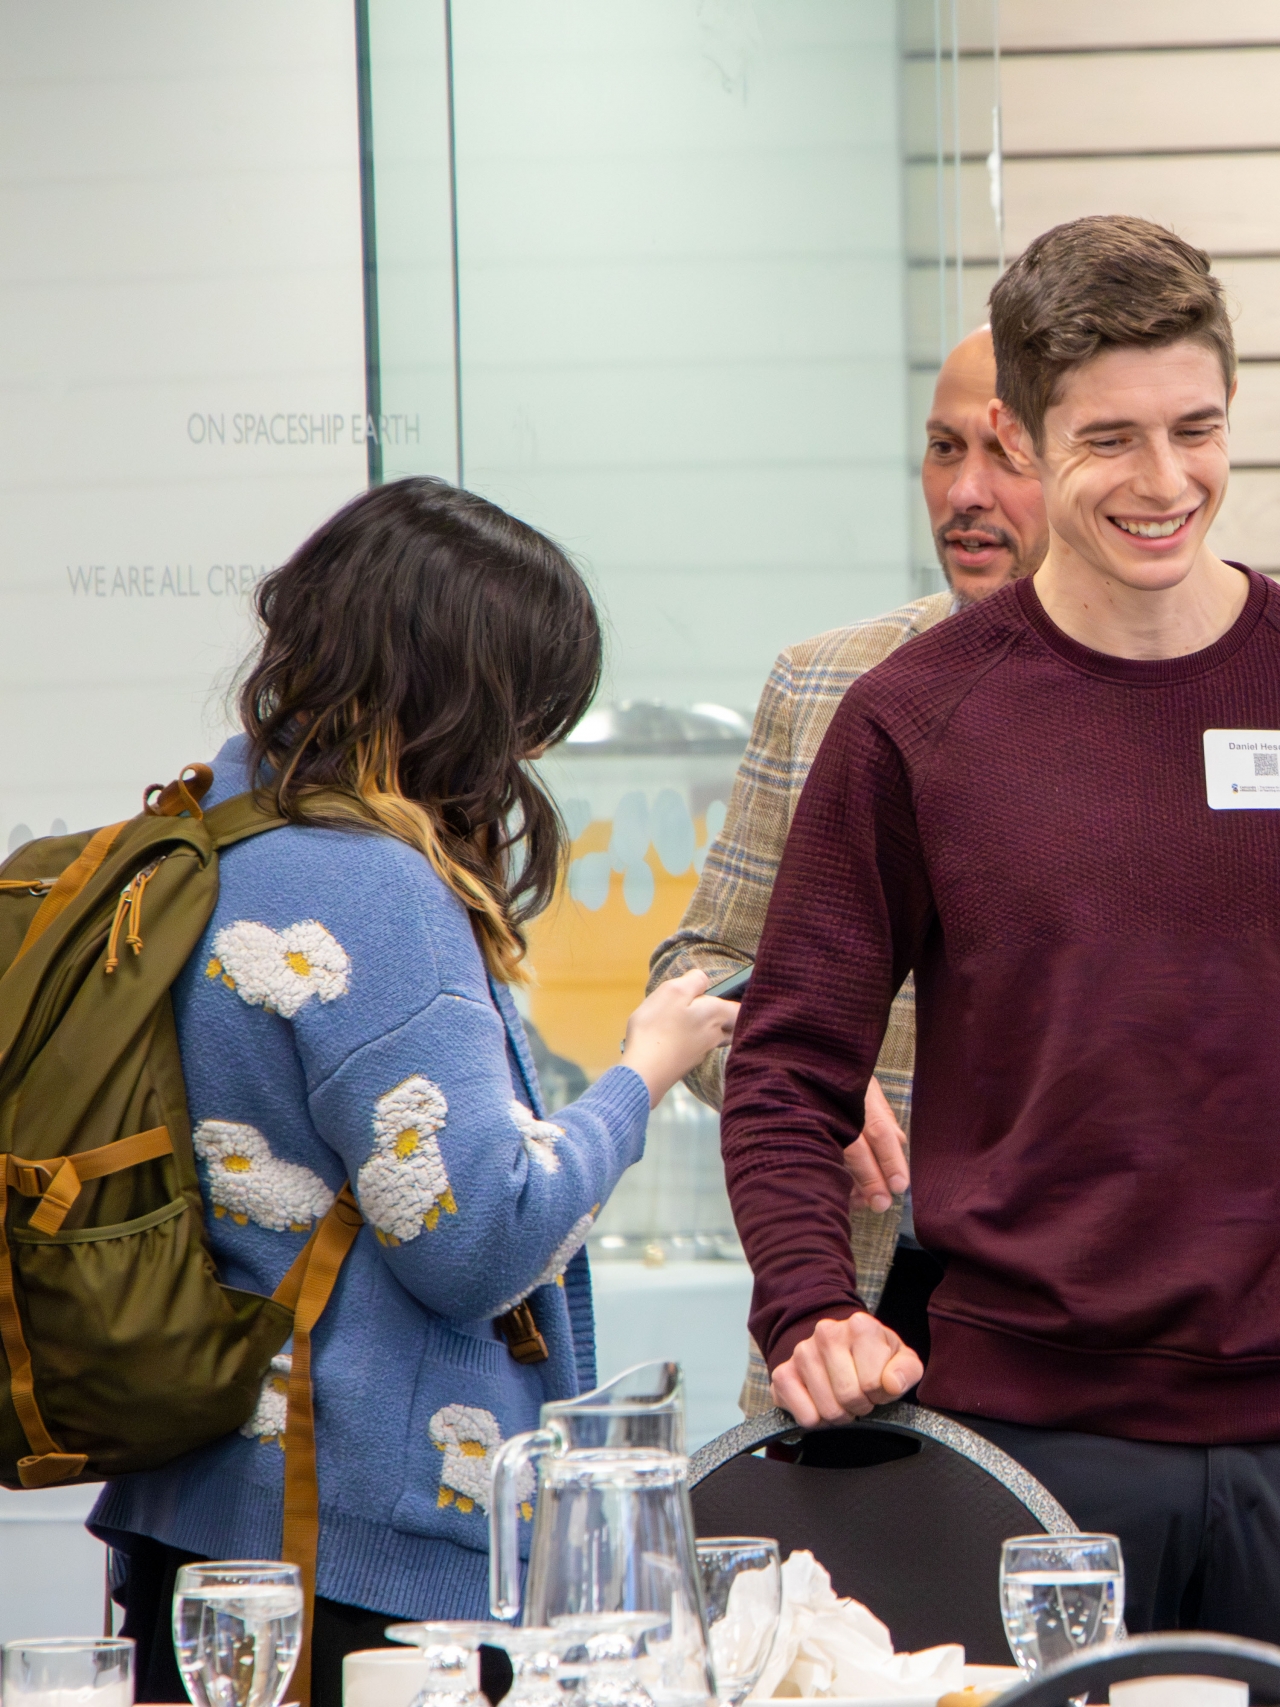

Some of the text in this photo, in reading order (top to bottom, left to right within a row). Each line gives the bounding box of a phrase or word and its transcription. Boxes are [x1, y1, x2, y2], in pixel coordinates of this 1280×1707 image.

[187, 412, 421, 445] ON SPACESHIP EARTH
[66, 564, 107, 597] WE
[110, 565, 155, 597] ARE
[159, 564, 201, 597] ALL
[1228, 742, 1258, 751] Daniel
